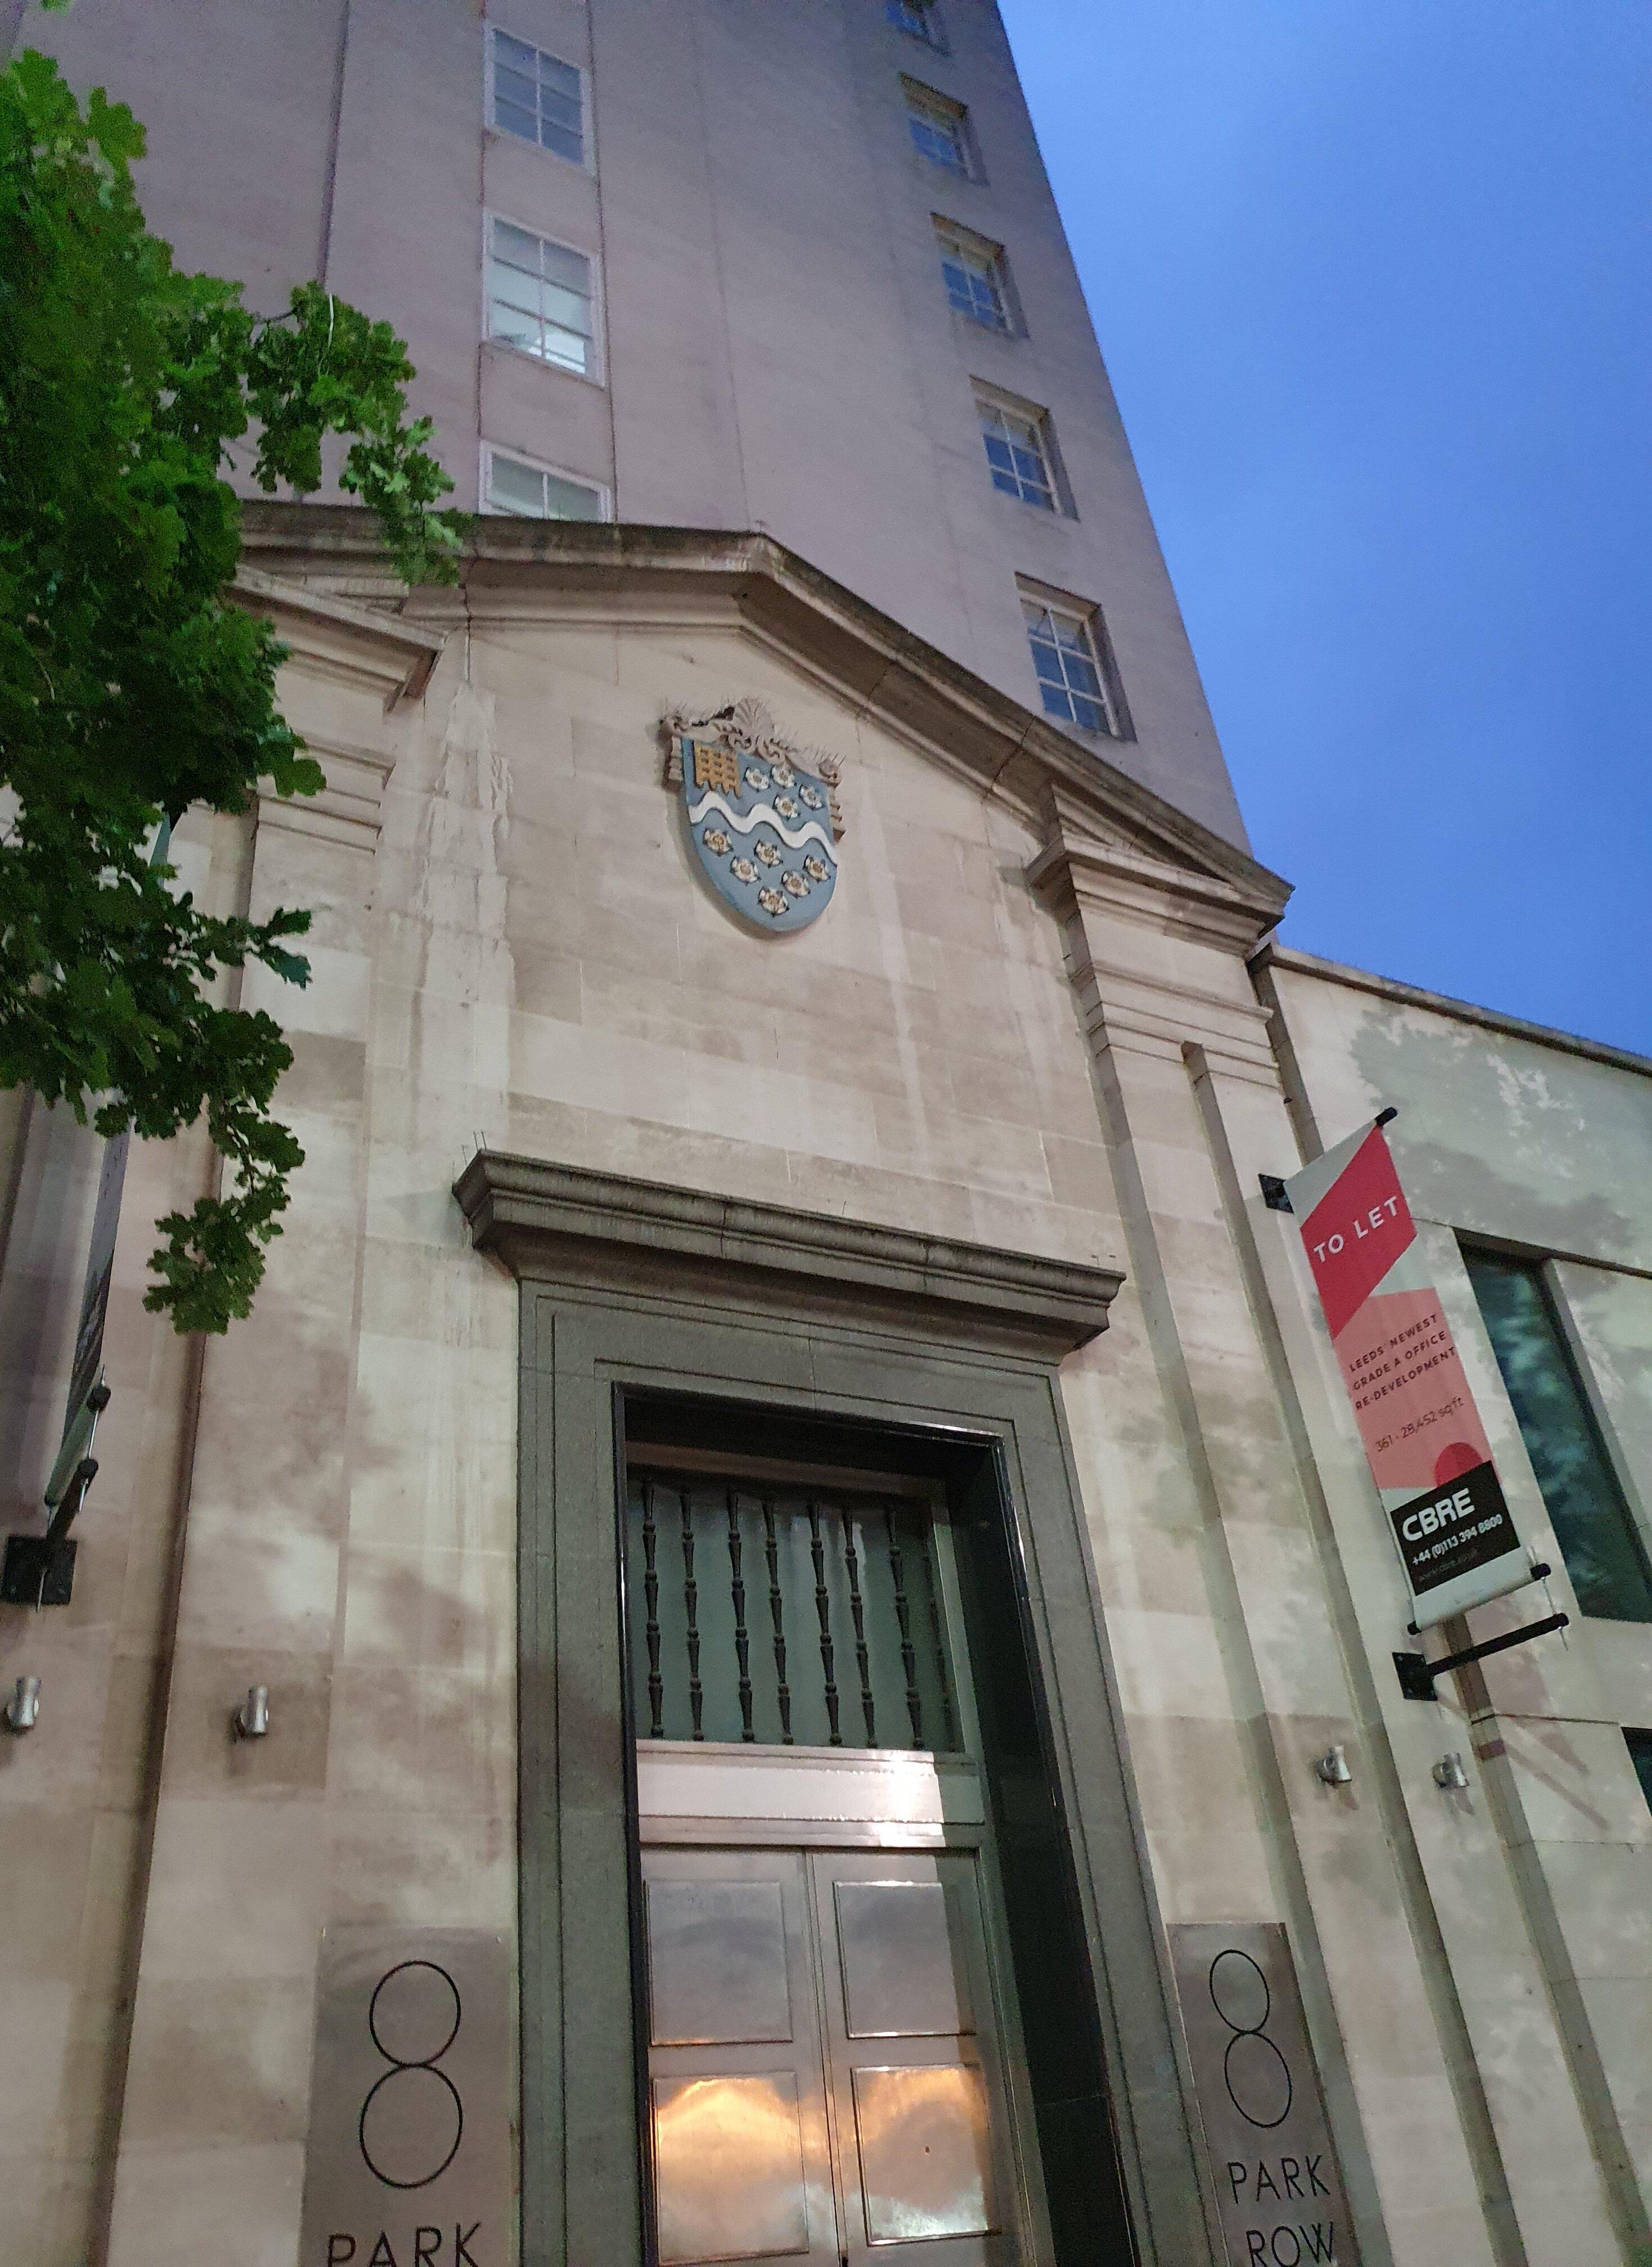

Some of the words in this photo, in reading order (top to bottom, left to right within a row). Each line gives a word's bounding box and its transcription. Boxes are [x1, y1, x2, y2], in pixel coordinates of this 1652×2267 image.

[1313, 1234, 1345, 1263] TO
[1353, 1195, 1398, 1239] LET
[1389, 1313, 1437, 1348] NEWEST
[1353, 1363, 1391, 1390] GRADE
[1394, 1357, 1402, 1368] A
[1404, 1330, 1447, 1360] OFFICE
[1355, 1346, 1456, 1410] RE-DEVELOPMENT
[1375, 1434, 1393, 1452] 361
[1400, 1411, 1438, 1439] 28,452
[1402, 1487, 1476, 1542] CBRE
[1412, 1548, 1432, 1565] +44
[1209, 1949, 1292, 2129] 8
[359, 1960, 463, 2189] 8
[1227, 2155, 1330, 2205] PARK
[328, 2219, 482, 2267] PARK
[1245, 2221, 1334, 2267] ROW
